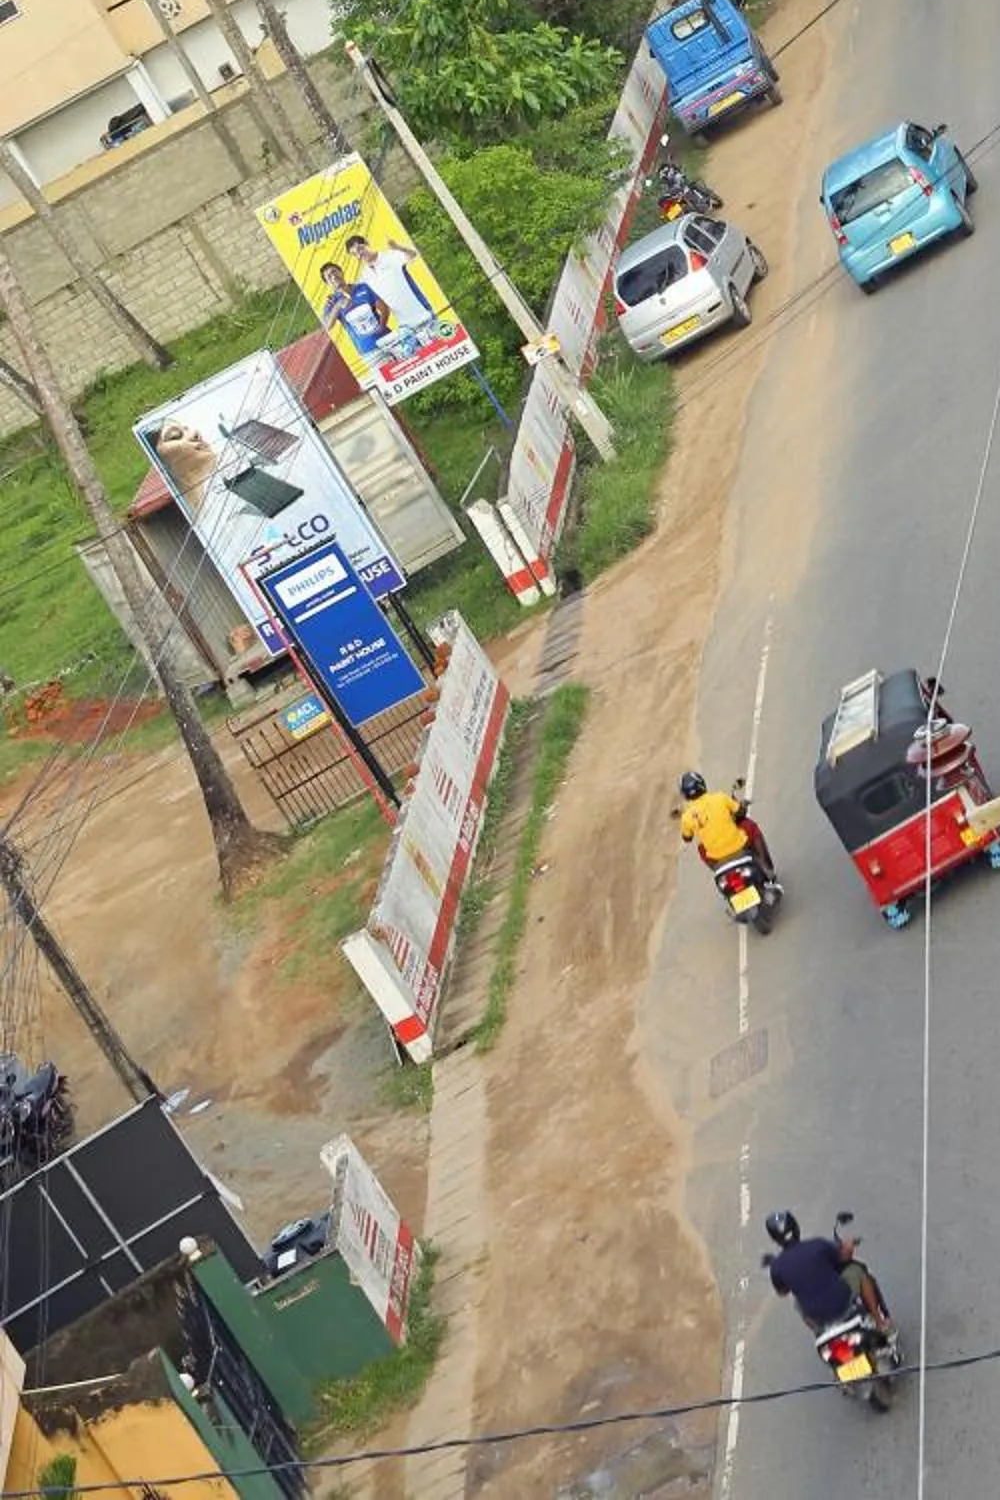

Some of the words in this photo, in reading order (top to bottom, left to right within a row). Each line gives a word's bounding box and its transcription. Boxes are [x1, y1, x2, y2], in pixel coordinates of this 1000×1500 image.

[297, 199, 361, 248] Nippolac
[403, 365, 434, 387] PAINT
[434, 345, 470, 371] HOUSE
[287, 566, 336, 597] PHILIPS
[355, 637, 387, 659] HOUSE
